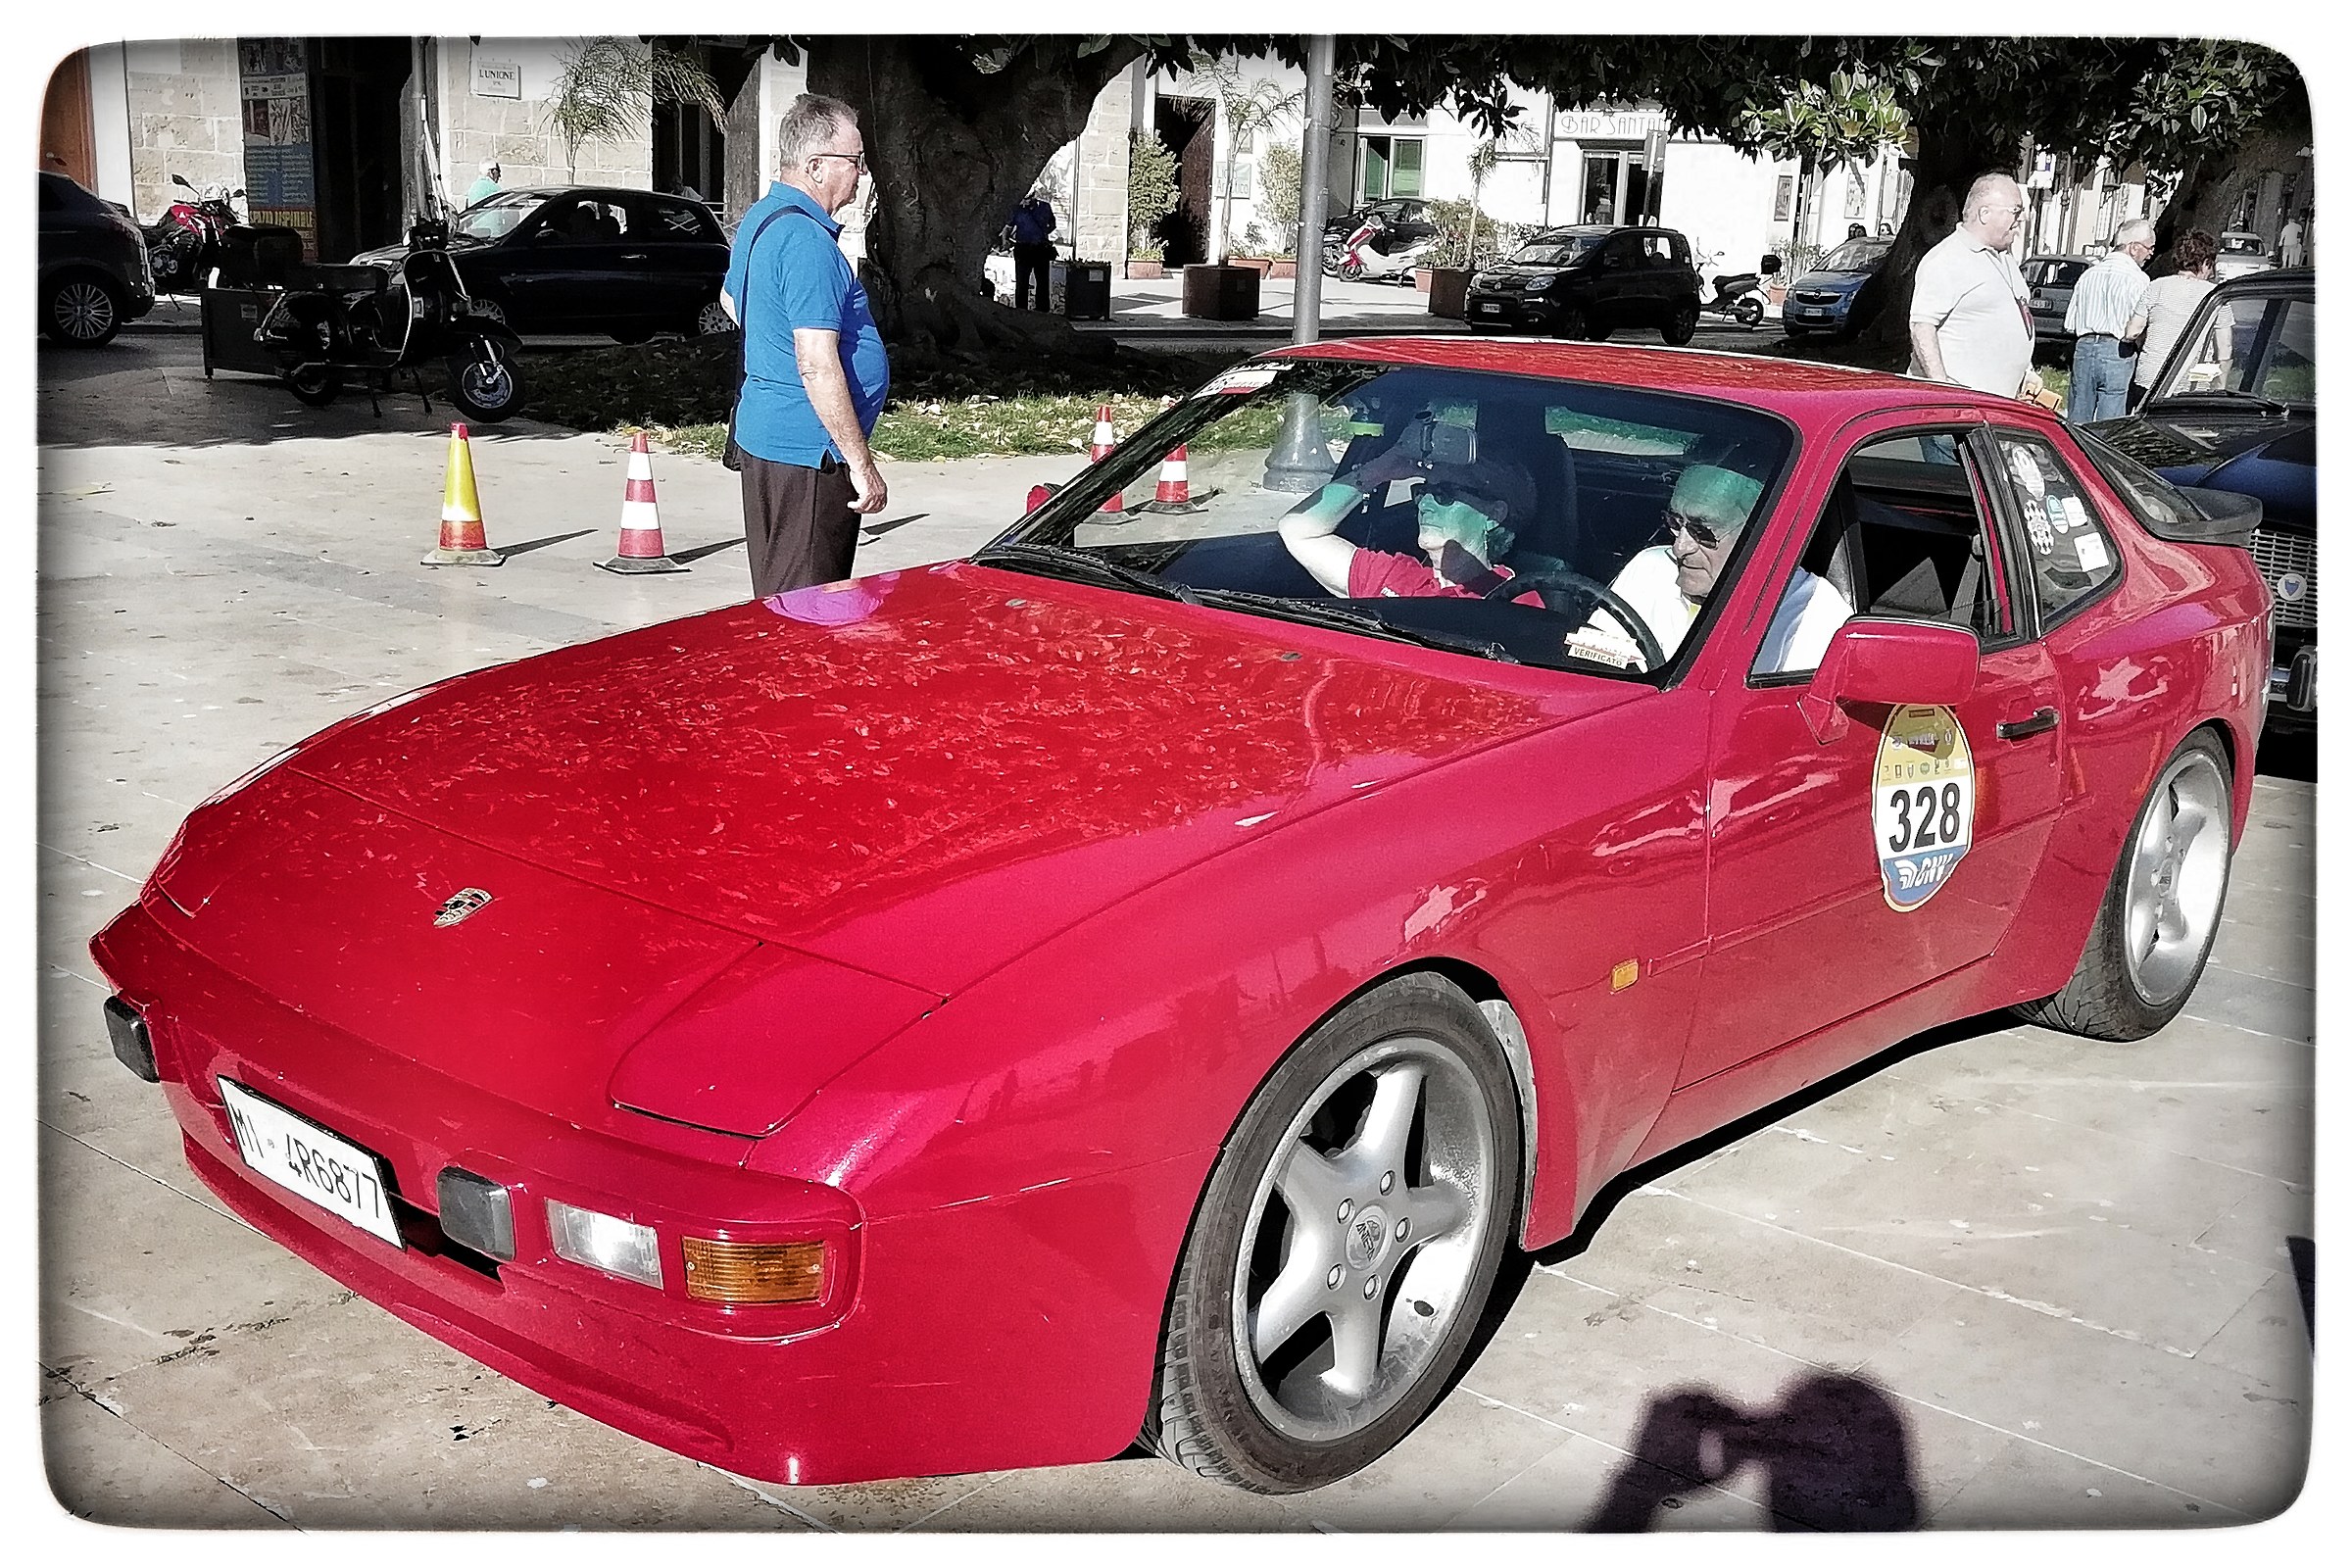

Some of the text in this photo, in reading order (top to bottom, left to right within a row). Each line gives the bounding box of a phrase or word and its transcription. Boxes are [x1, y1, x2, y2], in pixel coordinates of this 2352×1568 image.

[1560, 115, 1601, 134] BAR
[1574, 647, 1623, 666] VERIFICATO
[1888, 782, 1961, 853] 328
[229, 1102, 380, 1218] MI 4R6877
